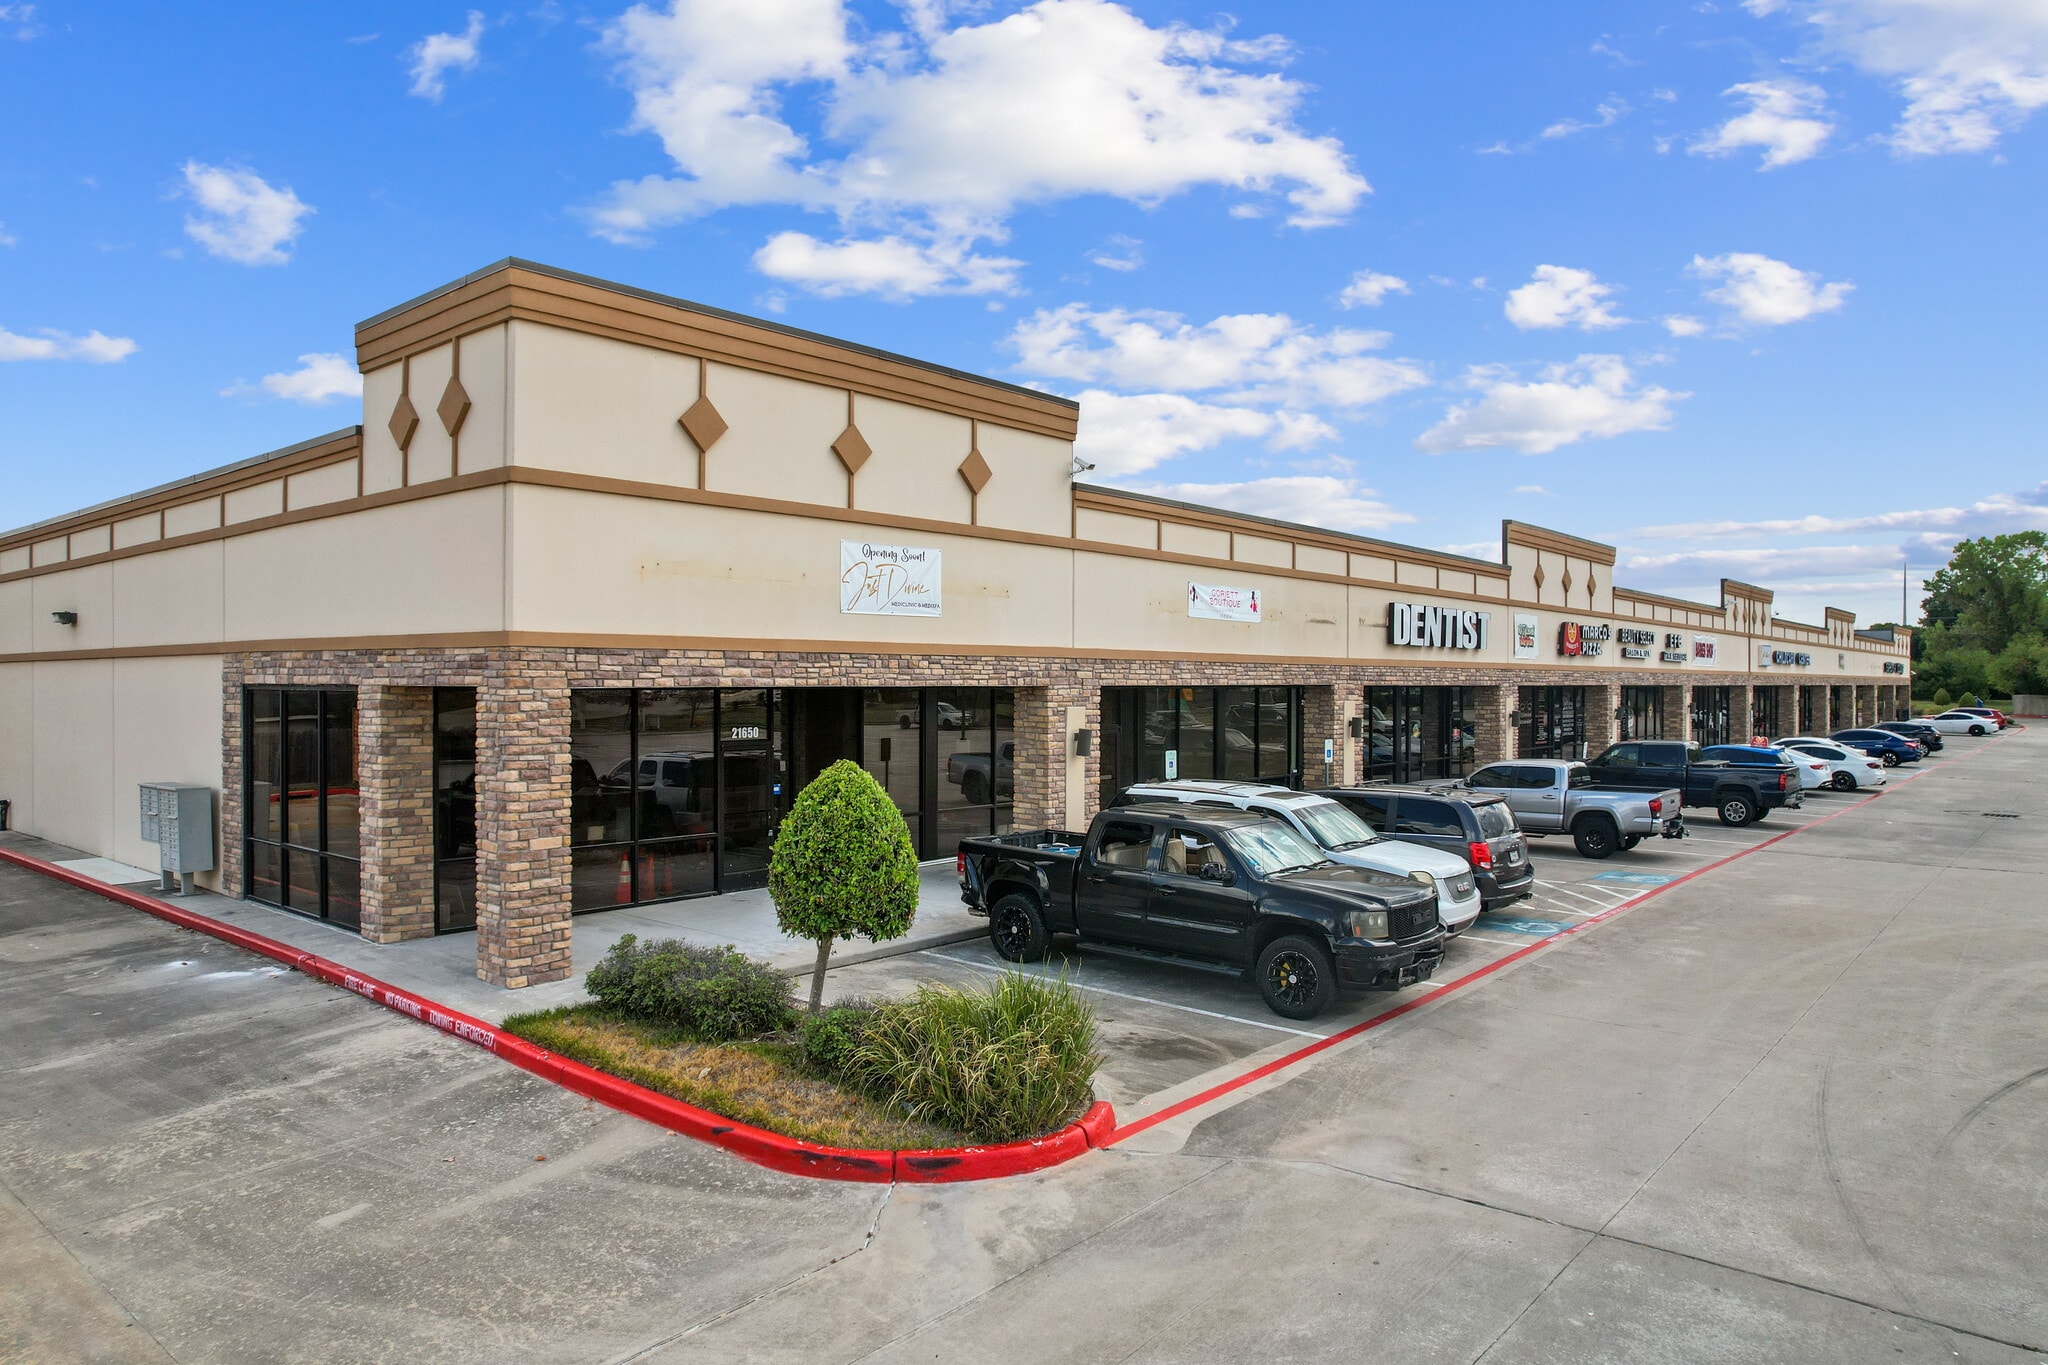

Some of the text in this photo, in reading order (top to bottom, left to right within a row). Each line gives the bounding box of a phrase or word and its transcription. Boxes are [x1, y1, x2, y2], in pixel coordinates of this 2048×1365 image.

[862, 543, 926, 563] Opening Soon!
[876, 563, 929, 611] Divine
[1209, 597, 1241, 608] BOUTIQUE
[1393, 602, 1491, 650] DENTIST
[1621, 628, 1656, 645] BEAUTY SELECT
[1582, 641, 1603, 656] PIZZA
[1626, 648, 1639, 656] SALON
[1672, 652, 1688, 661] SERVICE
[731, 726, 759, 739] 21650
[344, 974, 376, 998] FIRE LANE
[385, 991, 421, 1018] NO PARKING
[429, 1010, 494, 1046] TOWING ENFORCED
